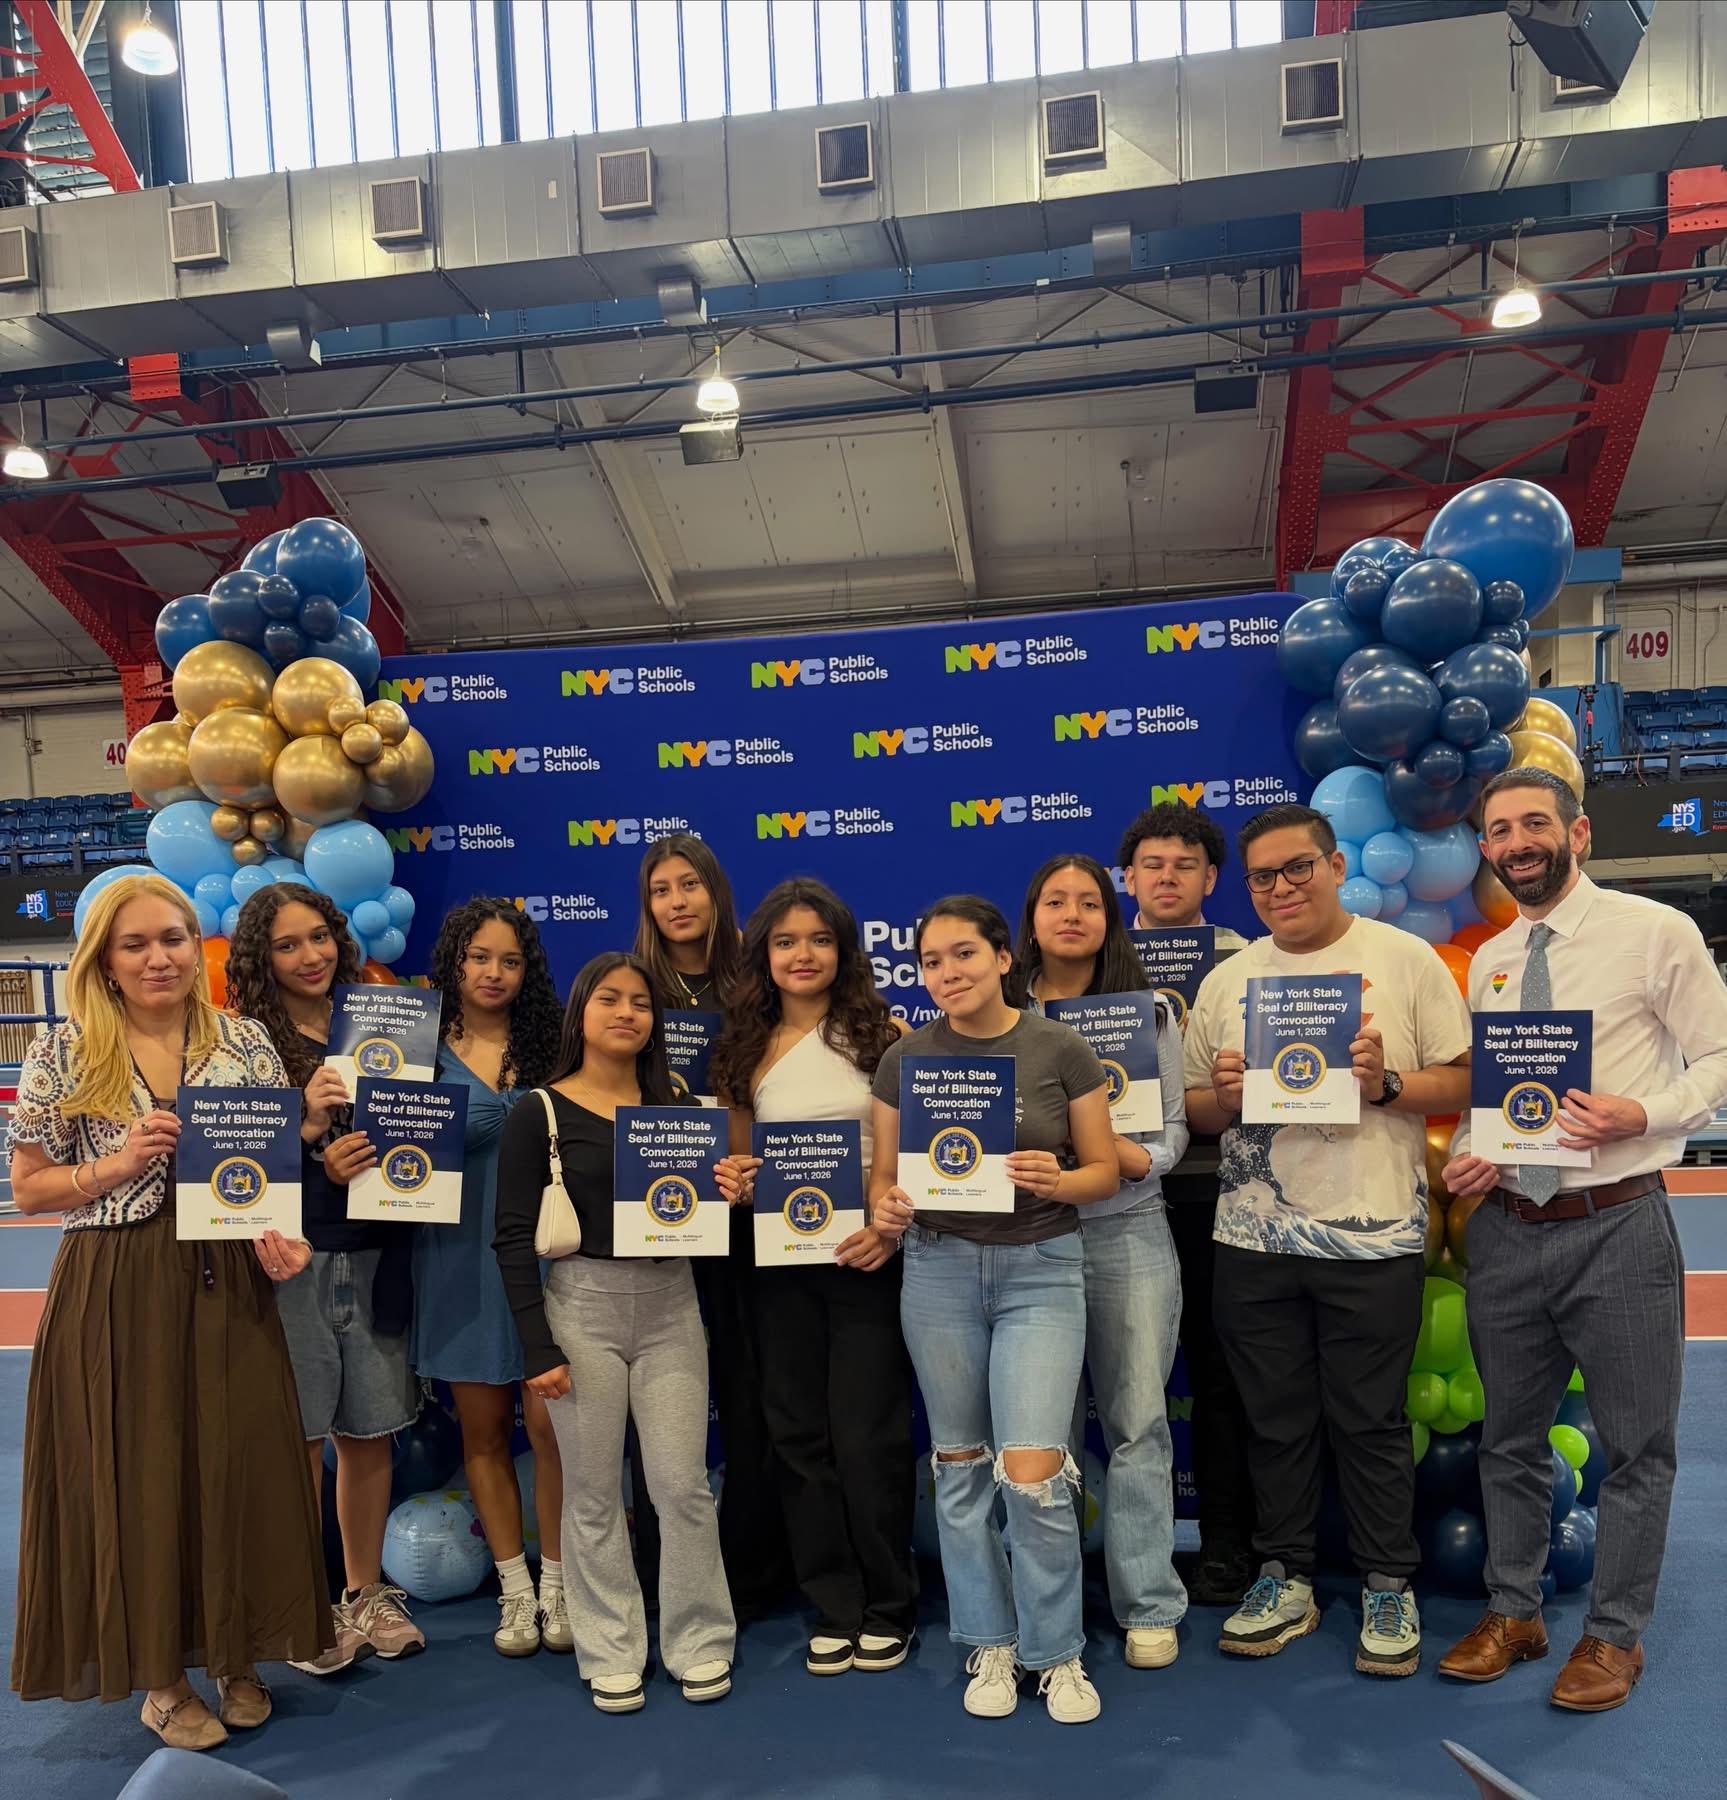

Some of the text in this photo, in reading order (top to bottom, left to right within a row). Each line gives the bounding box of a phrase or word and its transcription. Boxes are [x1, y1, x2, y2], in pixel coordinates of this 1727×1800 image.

[1230, 617, 1278, 632] Public
[1026, 636, 1073, 651] Public
[1147, 621, 1225, 653] NYC
[1231, 632, 1279, 646] Schoo
[1626, 631, 1668, 659] 409
[829, 655, 874, 669] Public
[945, 641, 1021, 672] NYC
[1027, 648, 1087, 665] Schools
[638, 666, 682, 679] Public
[752, 659, 825, 688] NYC
[830, 667, 888, 683] Schools
[452, 675, 494, 687] Public
[562, 669, 633, 696] NYC
[639, 679, 695, 693] Schools
[453, 687, 507, 700] Schools
[1137, 705, 1184, 720] Public
[933, 723, 979, 738] Public
[1055, 709, 1132, 741] NYC
[1138, 718, 1198, 733] Schools
[735, 738, 780, 751] Public
[854, 727, 928, 758] NYC
[934, 736, 992, 751] Schools
[106, 743, 126, 765] 40
[544, 746, 587, 758] Public
[658, 740, 731, 768] NYC
[736, 751, 793, 764] Schools
[469, 748, 539, 775] NYC
[545, 758, 600, 771] Schools
[1235, 777, 1283, 791] Public
[1031, 793, 1078, 807] Public
[1236, 790, 1297, 805] Schools
[951, 797, 1027, 827] NYC
[1032, 805, 1092, 821] Schools
[1672, 803, 1695, 812] NYS
[835, 808, 880, 821] Public
[1672, 813, 1696, 826] ED
[459, 824, 501, 836] Public
[644, 817, 688, 830] Public
[757, 811, 830, 839] NYC
[836, 820, 893, 834] Schools
[568, 819, 640, 846] NYC
[460, 836, 514, 849] Schools
[26, 893, 42, 902] NYS
[552, 895, 595, 907] Public
[27, 902, 44, 914] ED
[553, 907, 608, 920] Schools
[1149, 940, 1170, 949] York
[1173, 939, 1197, 948] State
[1147, 953, 1156, 961] of
[1159, 952, 1203, 960] Biliteracy
[347, 994, 423, 1006] New York State
[1260, 988, 1342, 1000] New York State
[380, 1005, 427, 1019] Biliteracy
[1060, 1006, 1136, 1020] New York State
[1257, 1003, 1279, 1013] Seal
[1283, 1002, 1293, 1011] of
[1296, 1002, 1347, 1012] Biliteracy
[352, 1014, 415, 1027] Convocation
[1082, 1021, 1092, 1031] of
[1095, 1019, 1142, 1029] Biliteracy
[1268, 1015, 1335, 1025] Convocation
[387, 1027, 406, 1035] 2026
[679, 1022, 704, 1032] State
[1297, 1028, 1303, 1037] 1,
[1305, 1027, 1326, 1035] 2026
[1488, 1025, 1572, 1035] New York State
[665, 1033, 709, 1046] Biliteracy
[1485, 1039, 1578, 1050] Seal of Biliteracy
[1098, 1043, 1125, 1053] 1, 2026
[672, 1057, 690, 1065] 2026
[1496, 1053, 1566, 1063] Convocation
[916, 1070, 996, 1080] New York State
[1505, 1066, 1557, 1075] June 1, 2026
[912, 1084, 1002, 1096] Seal of Biliteracy
[372, 1090, 450, 1104] New York State
[924, 1098, 990, 1108] Convocation
[195, 1100, 281, 1111] New York State
[368, 1103, 455, 1119] Seal of Biliteracy
[191, 1114, 287, 1126] Seal of Biliteracy
[931, 1111, 982, 1120] June 1, 2026
[377, 1115, 444, 1131] Convocation
[632, 1120, 711, 1130] New York State
[204, 1128, 274, 1138] Convocation
[385, 1129, 404, 1137] June
[413, 1131, 434, 1139] 2026
[767, 1134, 843, 1144] New York State
[213, 1141, 266, 1150] June 1, 2026
[628, 1134, 716, 1146] Seal of Biliteracy
[640, 1147, 705, 1157] Convocation
[764, 1147, 848, 1157] Seal of Biliteracy
[648, 1160, 697, 1169] June 1, 2026
[776, 1159, 838, 1169] Convocation
[811, 1171, 831, 1179] 2026
